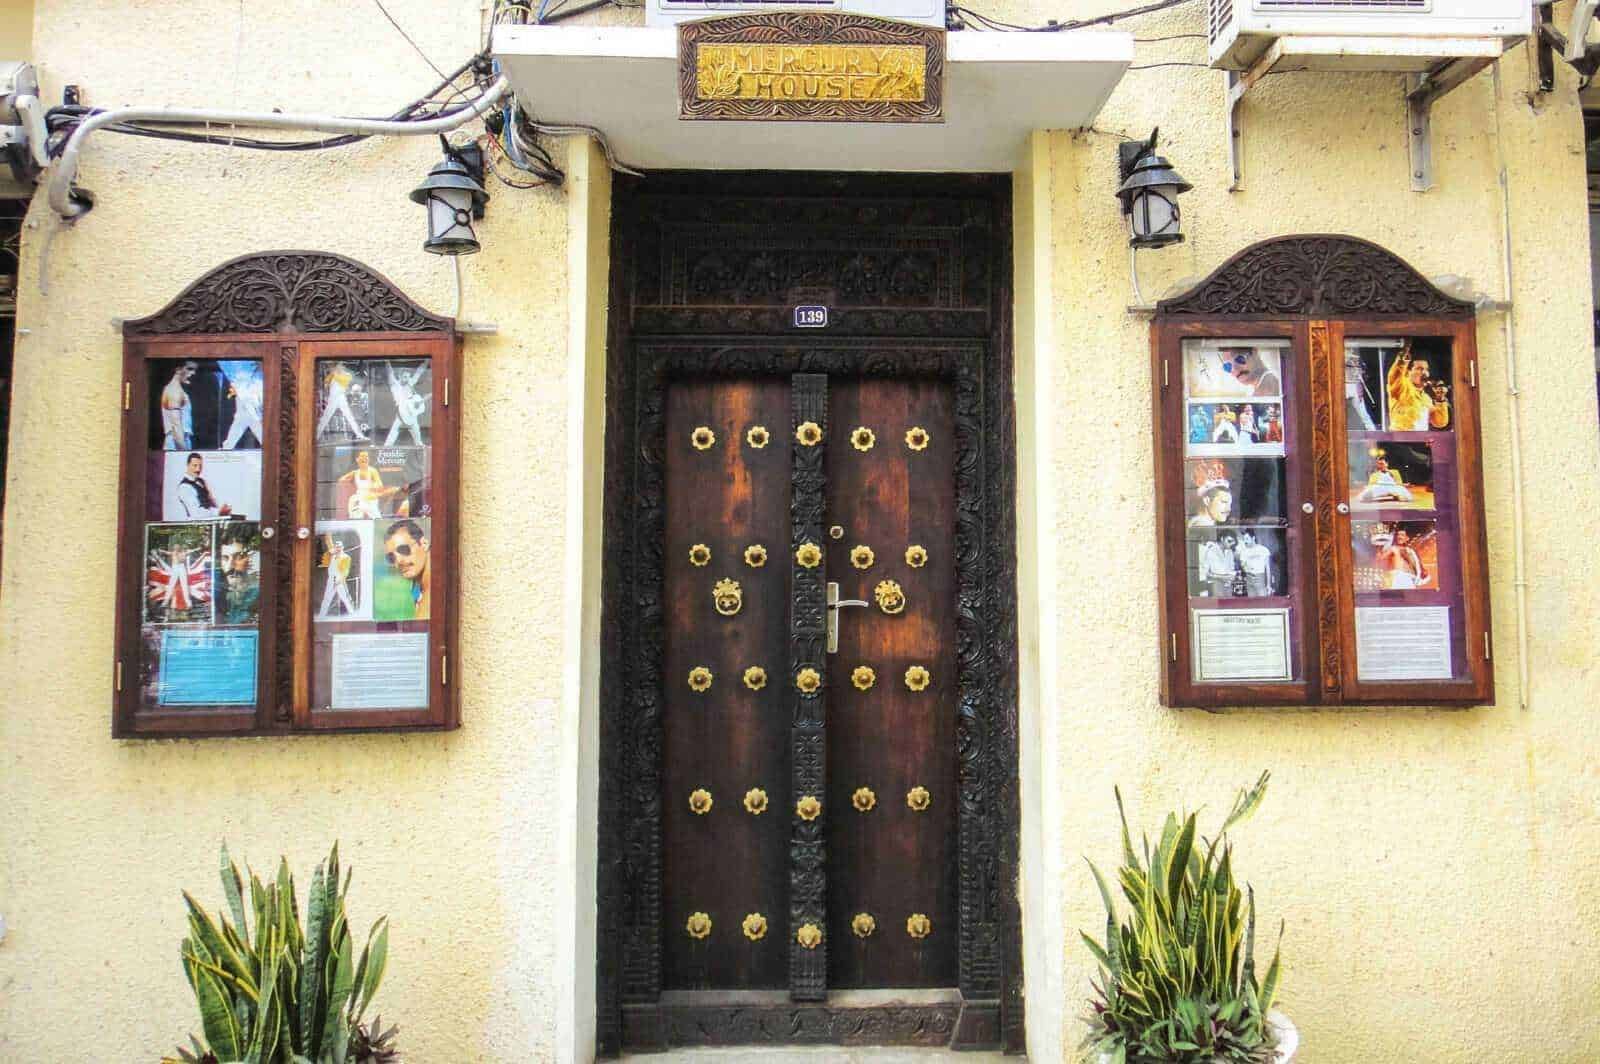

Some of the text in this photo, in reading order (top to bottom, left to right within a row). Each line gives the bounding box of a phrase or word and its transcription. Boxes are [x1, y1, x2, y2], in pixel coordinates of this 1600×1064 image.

[731, 46, 888, 73] MERCURY
[756, 75, 866, 97] HOUSE
[799, 310, 824, 323] 139
